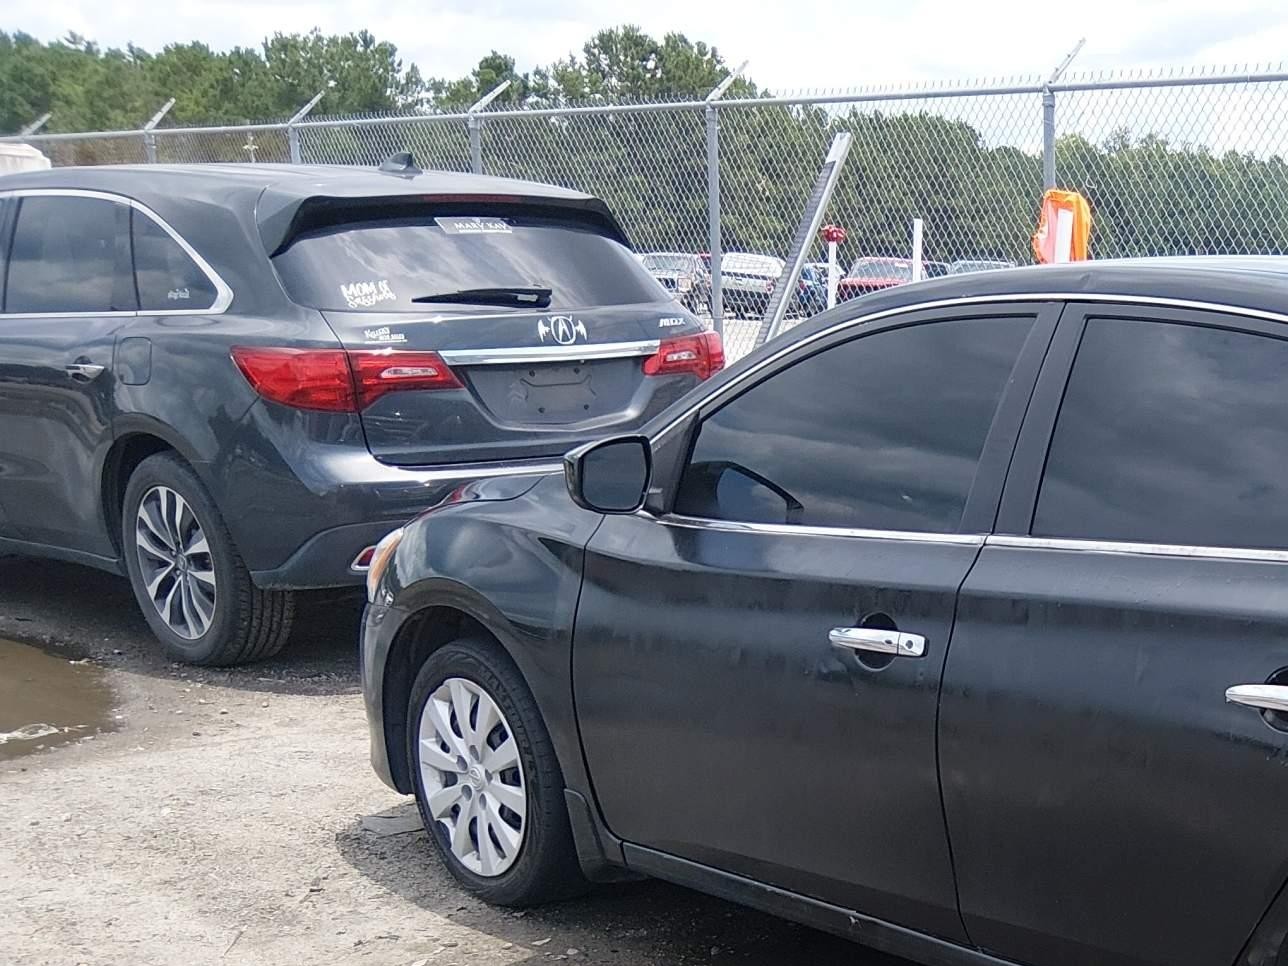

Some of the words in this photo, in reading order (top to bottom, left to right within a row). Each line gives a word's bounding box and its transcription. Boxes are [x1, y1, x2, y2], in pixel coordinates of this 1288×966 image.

[454, 222, 484, 230] MARY
[340, 281, 378, 298] MOM
[659, 317, 686, 328] MDX
